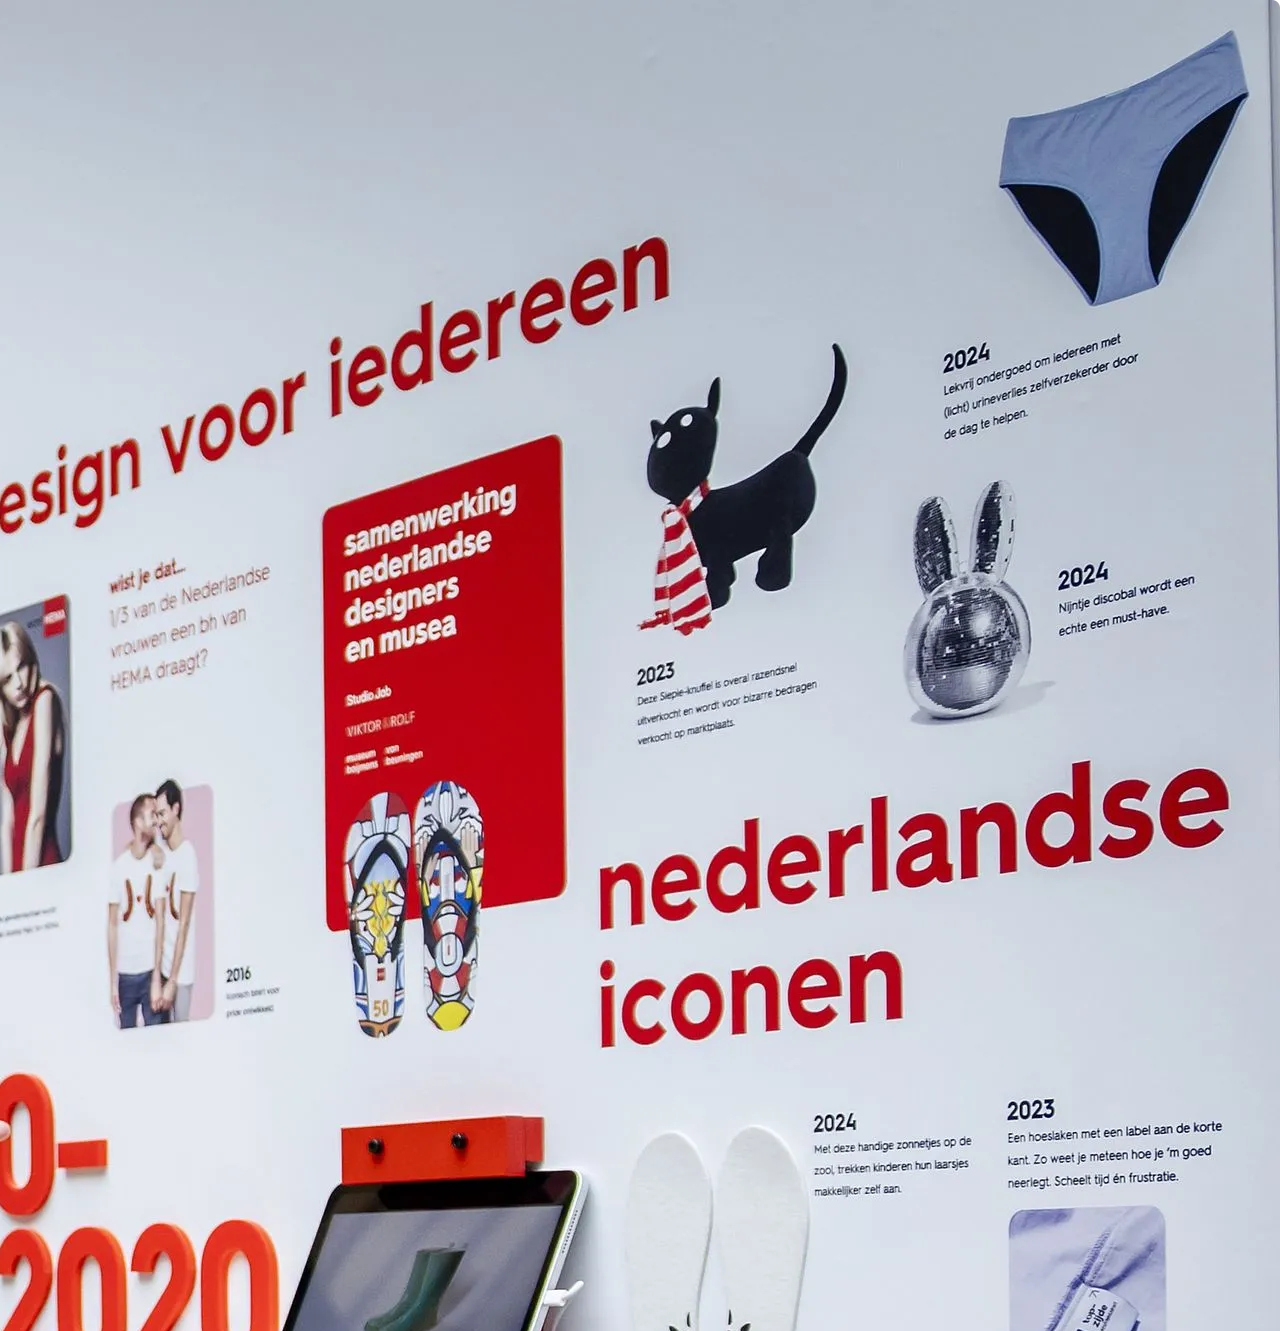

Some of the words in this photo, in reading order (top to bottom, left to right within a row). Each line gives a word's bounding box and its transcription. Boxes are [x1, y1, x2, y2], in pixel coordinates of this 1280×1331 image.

[160, 371, 307, 474] voor
[329, 236, 670, 417] iedereen
[942, 342, 991, 373] 2024
[943, 377, 974, 396] Lekvrij
[976, 359, 1031, 386] ondergoed
[1034, 356, 1050, 369] om
[1052, 342, 1098, 363] iedereen
[1100, 333, 1121, 349] met
[943, 400, 969, 419] (licht)
[972, 386, 1027, 410] urineverlies
[1029, 361, 1110, 393] zelfverzekerder
[1112, 353, 1138, 369] door
[943, 428, 956, 440] de
[958, 423, 978, 436] dag
[980, 418, 990, 429] te
[992, 409, 1028, 426] helpen.
[344, 480, 517, 558] samenwerking
[109, 571, 135, 594] wist
[137, 568, 150, 591] je
[154, 557, 186, 580] dat...
[344, 527, 492, 594] nederlandse
[1057, 560, 1109, 592] 2024
[109, 605, 128, 628] 1/3
[133, 601, 156, 619] van
[159, 593, 177, 612] de
[181, 565, 270, 605] Nederlandse
[344, 575, 460, 630] designers
[1058, 598, 1090, 614] Nijntje
[1092, 586, 1136, 606] discobal
[1139, 578, 1172, 595] wordt
[1174, 576, 1194, 588] een
[110, 631, 166, 658] vrouwen
[170, 622, 196, 642] een
[199, 614, 217, 634] bh
[221, 607, 246, 626] van
[1058, 622, 1087, 637] echte
[1090, 618, 1109, 630] een
[1112, 605, 1169, 625] must-have.
[344, 636, 374, 663] en
[379, 614, 457, 654] musea
[110, 665, 152, 691] HEMA
[155, 647, 208, 679] draagt?
[636, 661, 676, 686] 2023
[345, 690, 374, 707] Studio
[374, 685, 392, 700] Job
[345, 719, 382, 737] VIKTOR
[390, 710, 415, 728] ROLF
[599, 760, 1230, 931] nederlandse
[226, 966, 251, 983] 2016
[373, 1000, 389, 1017] 50
[599, 950, 905, 1048] iconen
[813, 1112, 857, 1133] 2024
[1006, 1099, 1055, 1121] 2023
[814, 1144, 831, 1154] Met
[833, 1143, 856, 1153] deze
[858, 1141, 894, 1153] handige
[896, 1138, 941, 1150] zonnetjes
[943, 1138, 956, 1149] op
[958, 1135, 972, 1146] de
[1007, 1132, 1026, 1143] Een
[1028, 1129, 1078, 1142] hoeslaken
[1080, 1127, 1100, 1139] met
[1103, 1128, 1123, 1138] een
[1125, 1124, 1150, 1137] label
[1153, 1125, 1173, 1135] aan
[1175, 1122, 1190, 1134] de
[1193, 1120, 1222, 1132] korte
[1007, 1155, 1030, 1166] kant.
[1033, 1153, 1047, 1165] Zo
[1050, 1152, 1075, 1164] weet
[1076, 1152, 1086, 1165] je
[1089, 1150, 1128, 1161] meteen
[1131, 1148, 1152, 1159] hoe
[1153, 1147, 1164, 1161] je
[1182, 1144, 1212, 1160] goed
[1008, 1176, 1051, 1190] neerlegt.
[1054, 1174, 1091, 1186] Scheelt
[1094, 1173, 1110, 1187] tijd
[1112, 1172, 1126, 1184] én
[1128, 1170, 1178, 1183] frustratie.
[1093, 1304, 1108, 1328] zijde
